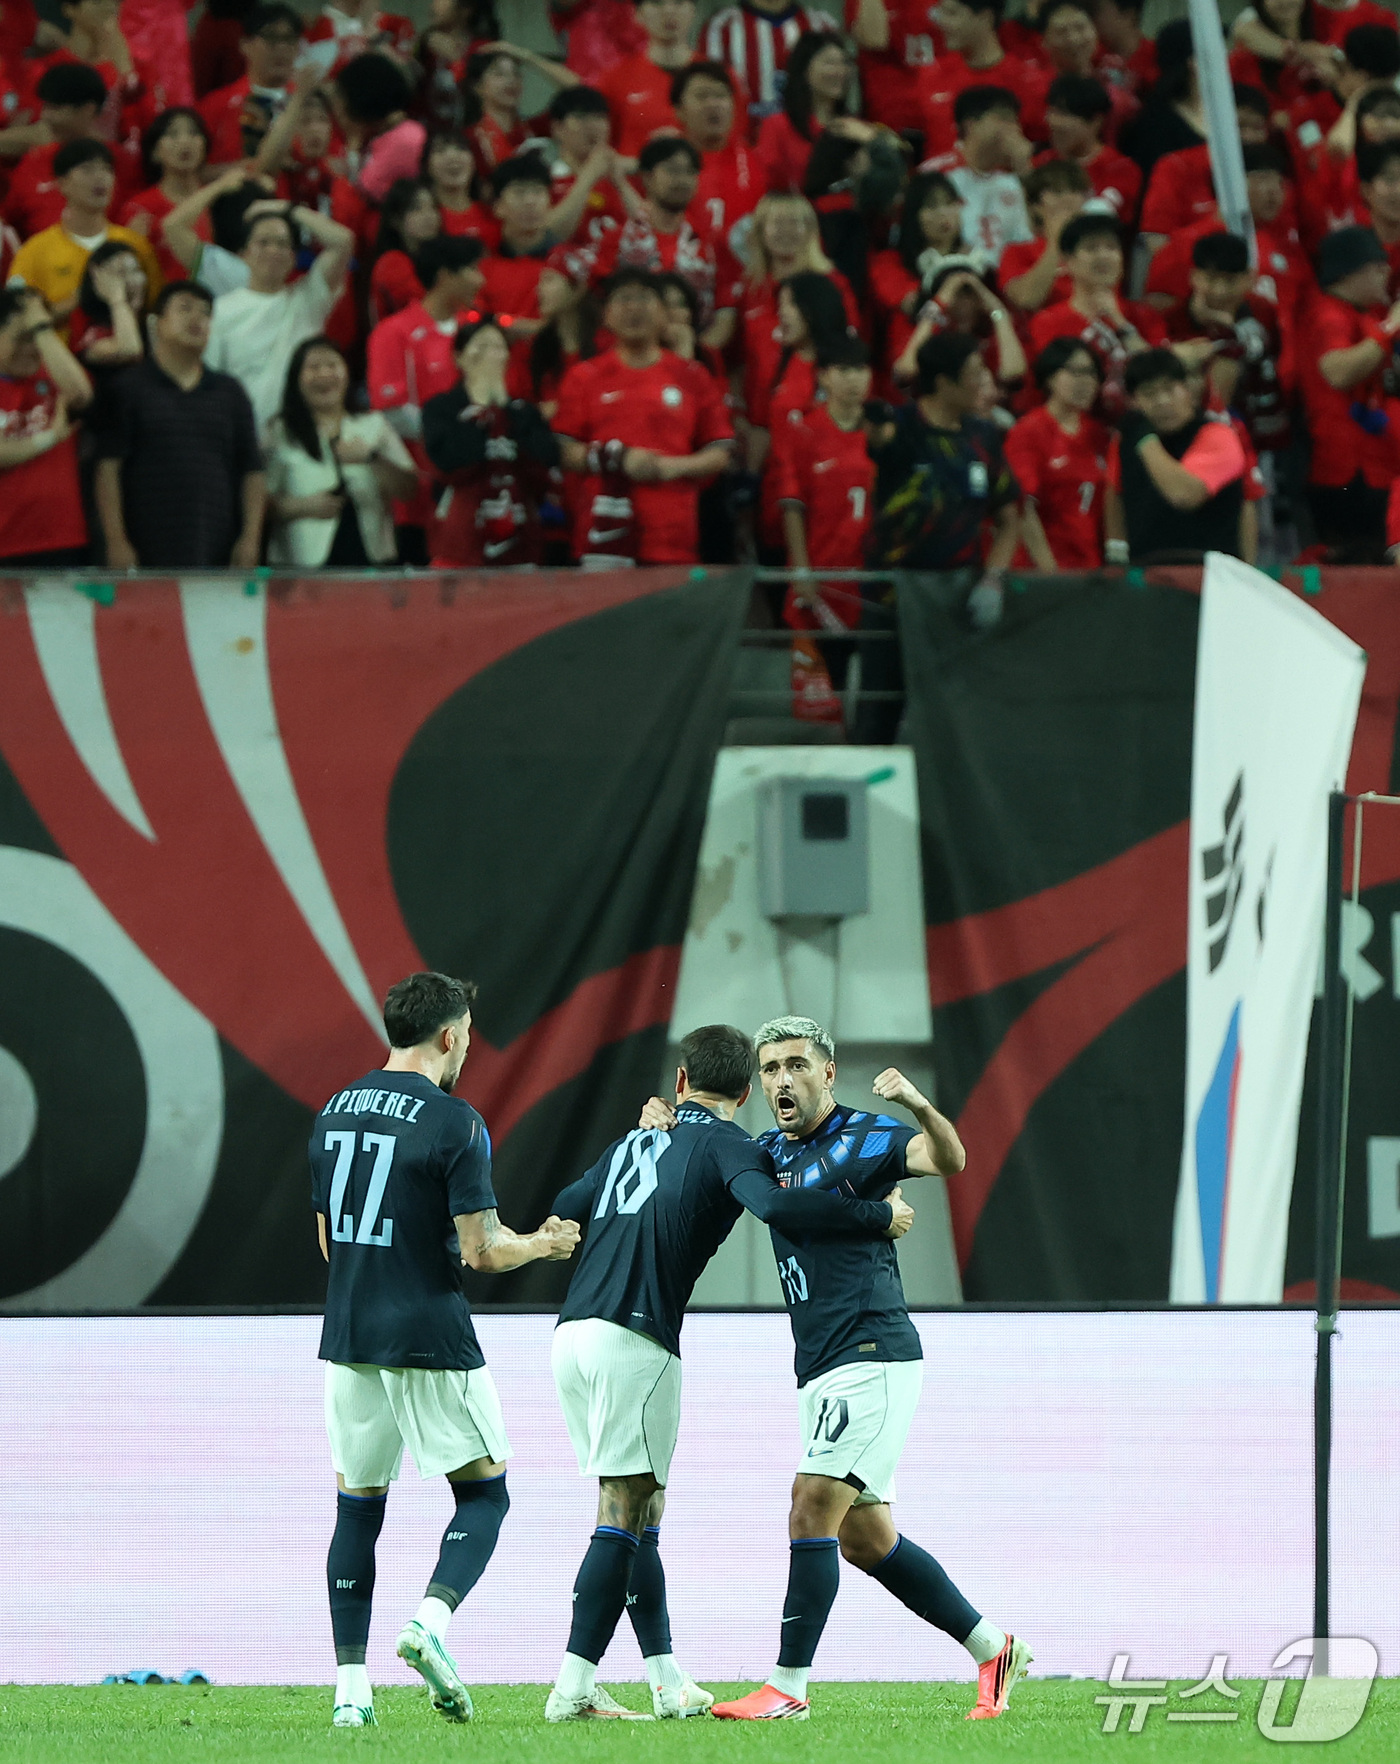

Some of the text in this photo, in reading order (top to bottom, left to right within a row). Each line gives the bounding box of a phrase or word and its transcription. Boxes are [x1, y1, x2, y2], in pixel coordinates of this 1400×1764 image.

[324, 1131, 397, 1247] 22
[594, 1127, 672, 1220] 18
[778, 1255, 809, 1305] 10
[813, 1398, 849, 1443] 10
